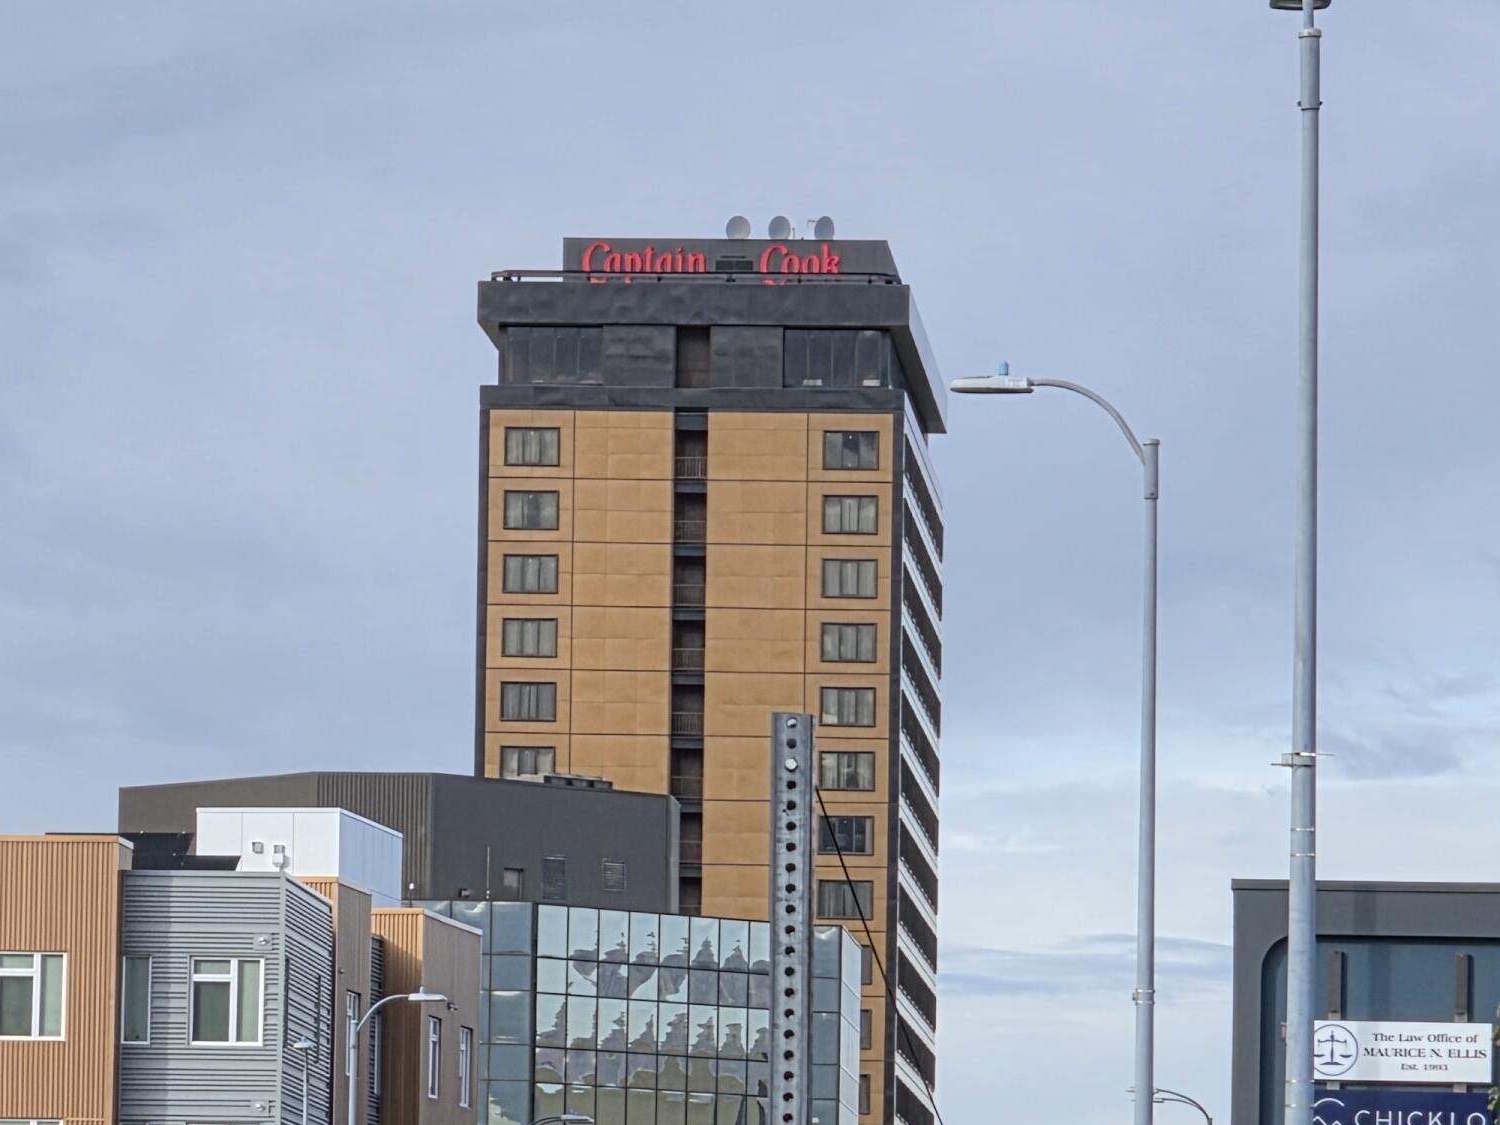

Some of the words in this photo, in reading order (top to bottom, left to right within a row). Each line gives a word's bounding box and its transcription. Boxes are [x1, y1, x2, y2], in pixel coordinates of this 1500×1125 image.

[582, 242, 706, 284] Captain
[759, 243, 842, 285] Cook
[1372, 1033, 1395, 1042] The
[1399, 1033, 1423, 1042] Law
[1427, 1033, 1462, 1043] Office
[1466, 1034, 1478, 1043] of
[1363, 1047, 1426, 1058] MAURICE
[1448, 1049, 1488, 1059] ELLIS
